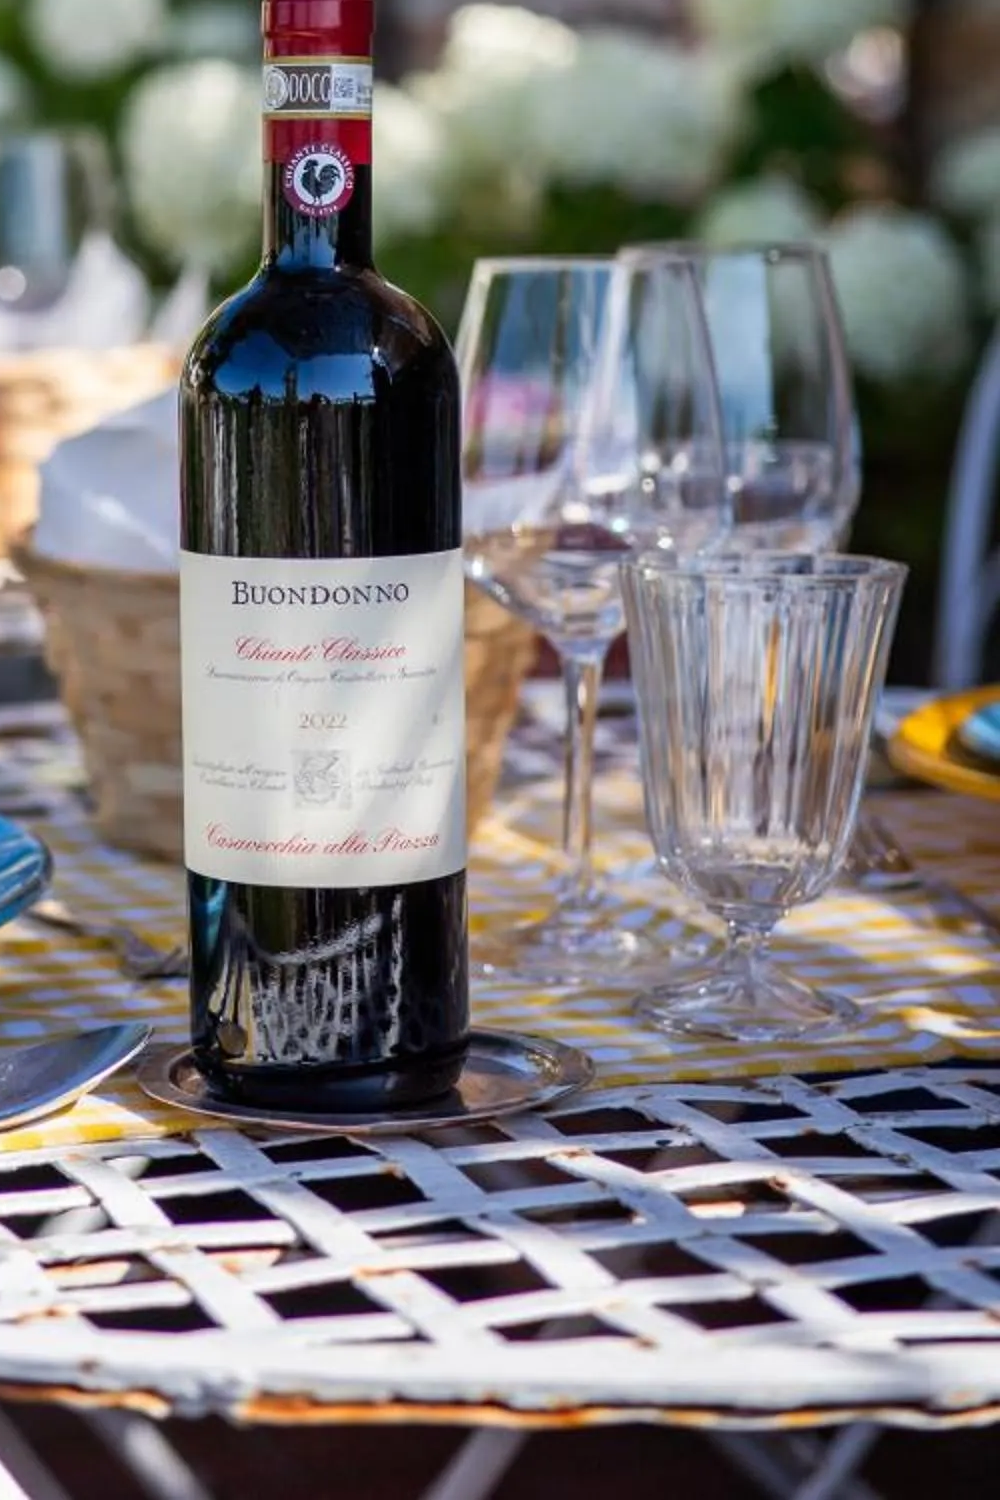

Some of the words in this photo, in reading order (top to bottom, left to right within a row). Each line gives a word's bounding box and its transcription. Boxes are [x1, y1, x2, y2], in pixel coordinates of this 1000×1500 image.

[231, 581, 410, 606] BUONDONNO
[234, 636, 317, 662] Chianti
[321, 636, 407, 662] Classico
[298, 713, 348, 730] 2022
[323, 830, 371, 855] alla
